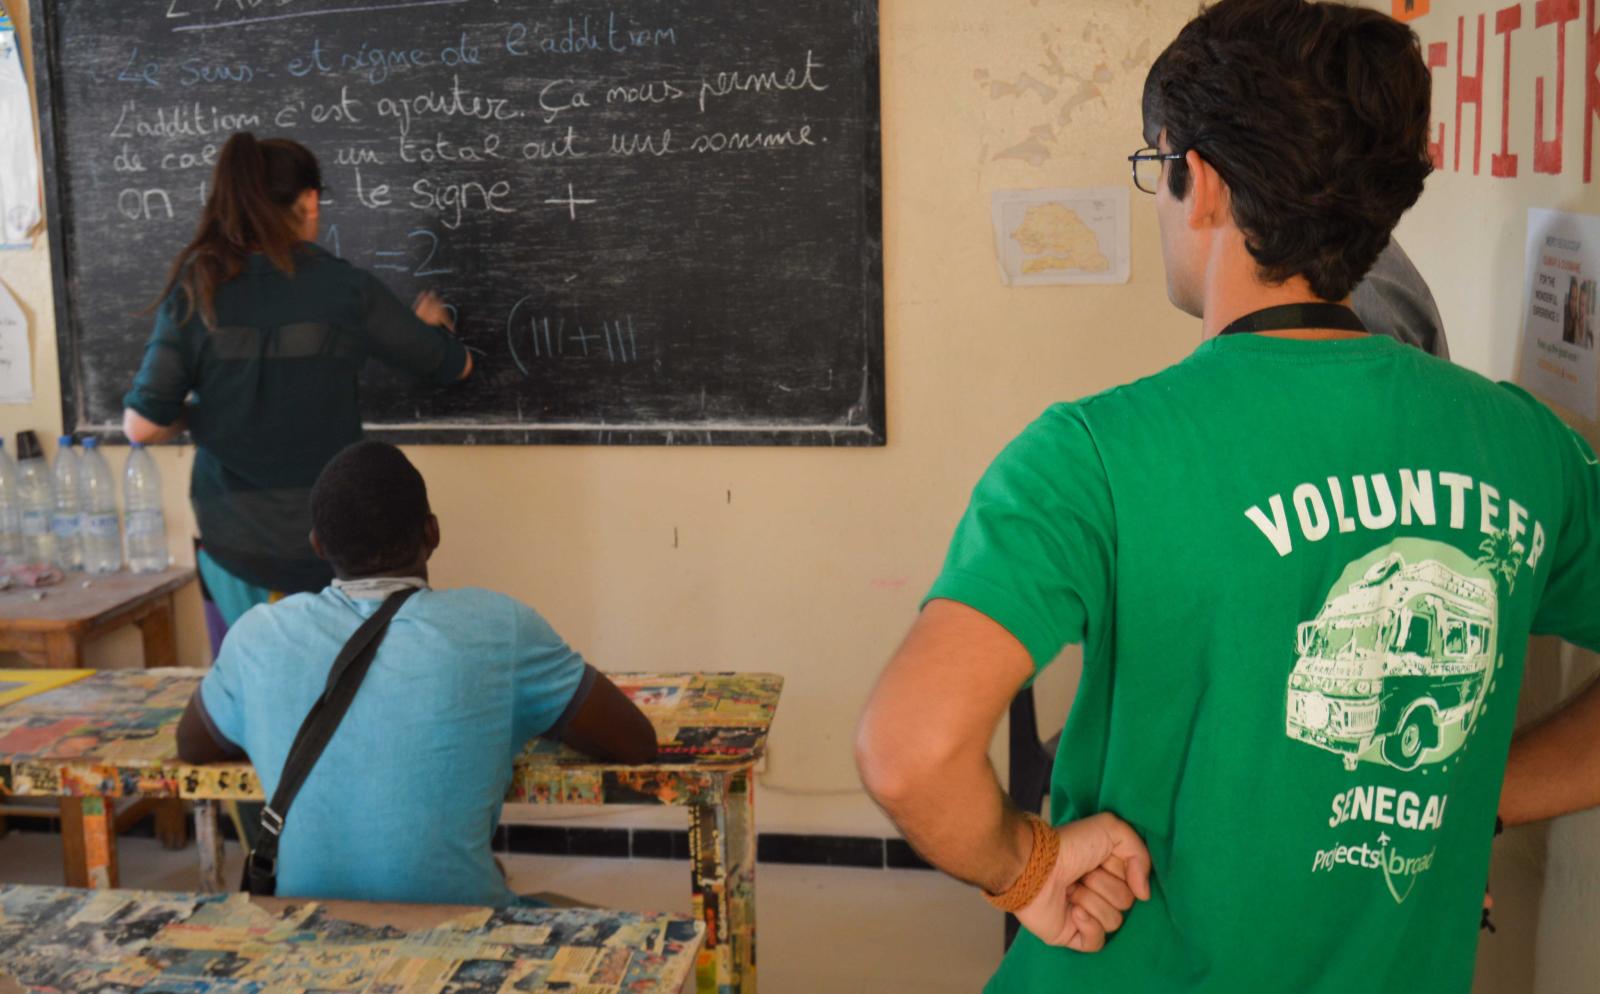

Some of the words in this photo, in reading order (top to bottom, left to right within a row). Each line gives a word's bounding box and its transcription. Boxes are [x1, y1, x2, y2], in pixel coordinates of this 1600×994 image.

[288, 37, 332, 77] et
[440, 31, 481, 66] de
[540, 79, 591, 123] Ça
[607, 81, 684, 104] nous
[700, 49, 829, 113] permet
[113, 143, 147, 172] de
[401, 131, 506, 163] total
[1244, 468, 1546, 572] VOLUNTEER
